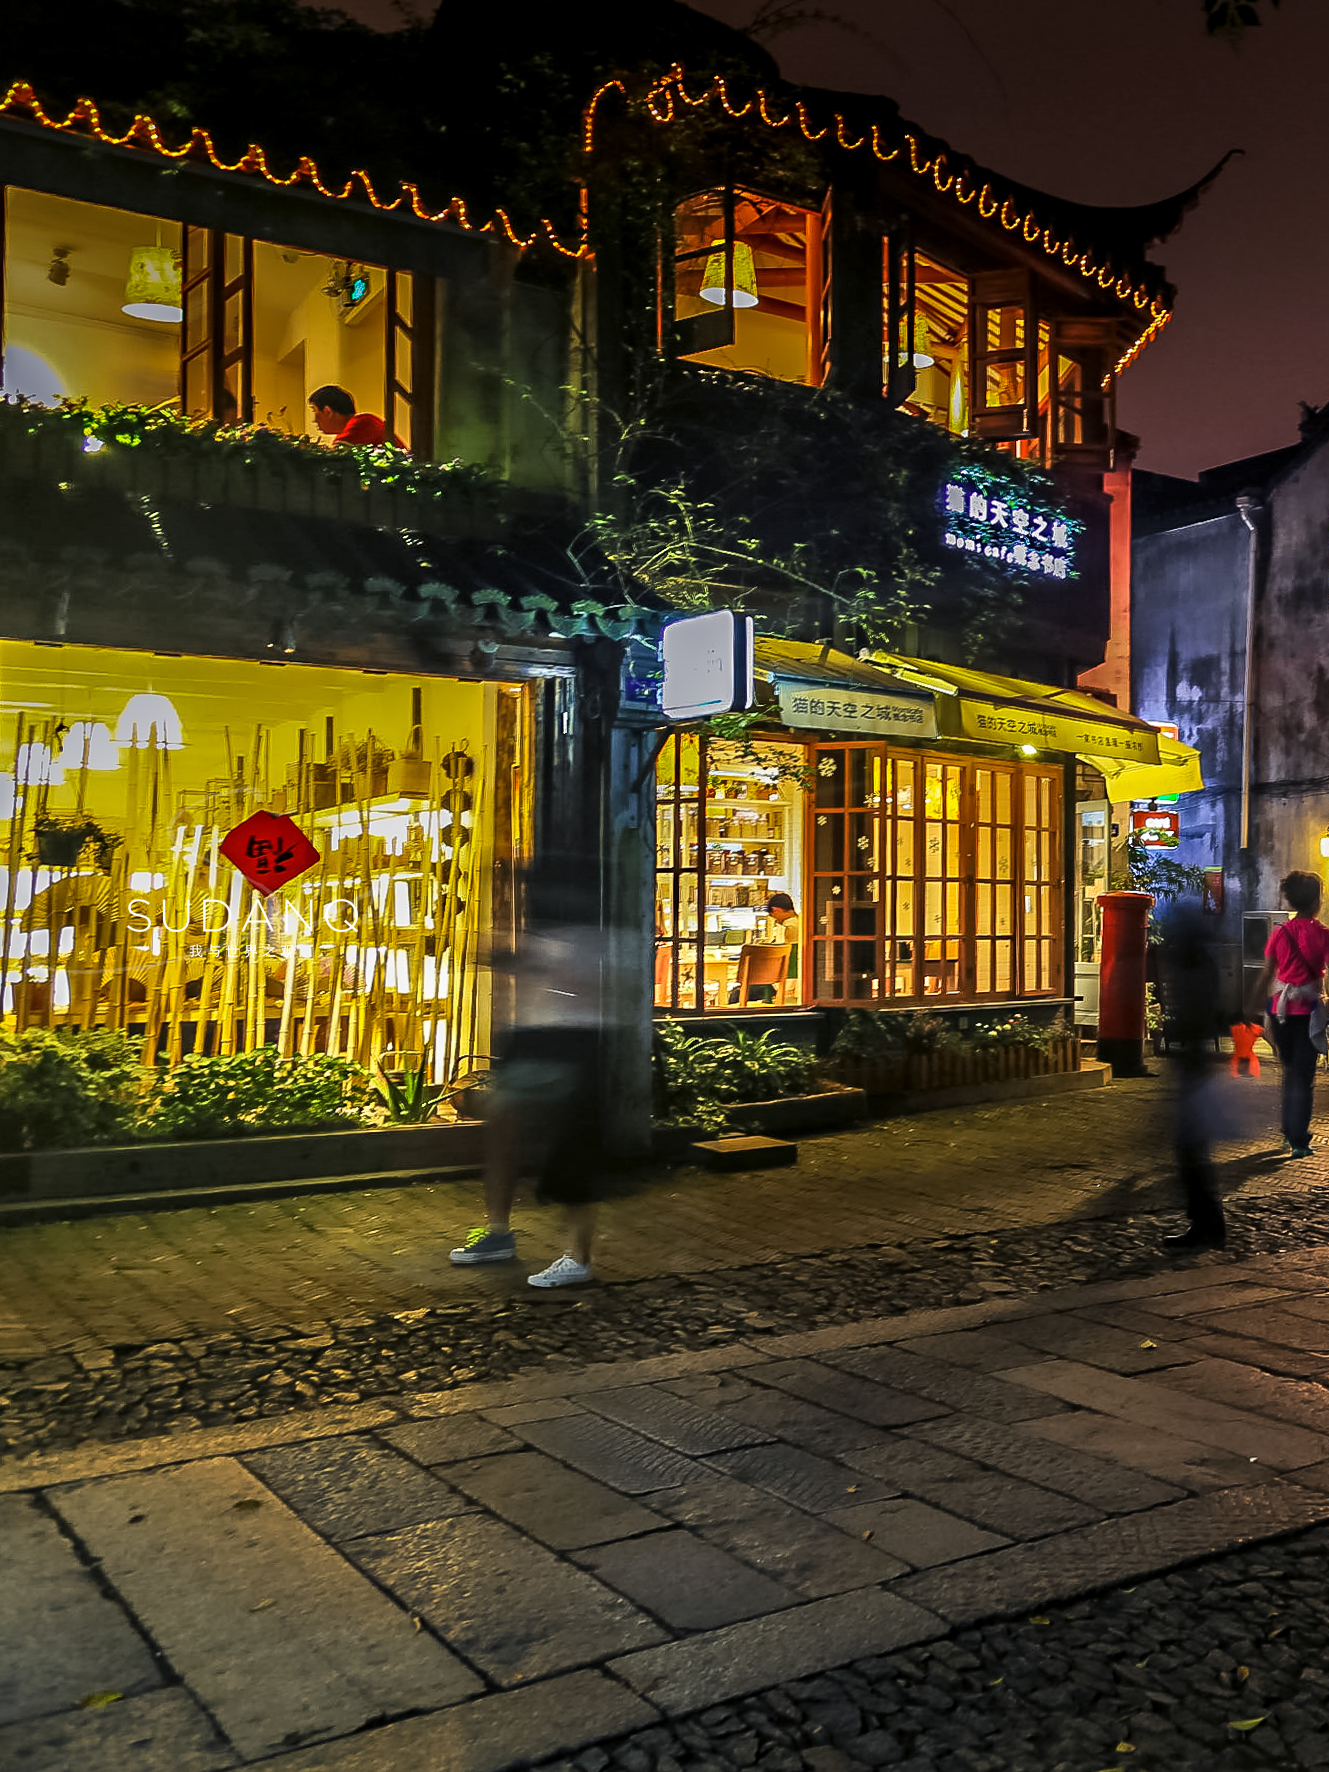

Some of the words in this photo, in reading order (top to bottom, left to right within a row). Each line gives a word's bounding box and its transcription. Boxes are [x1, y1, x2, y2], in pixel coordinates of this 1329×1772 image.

[792, 697, 892, 721] 猫的天空之城
